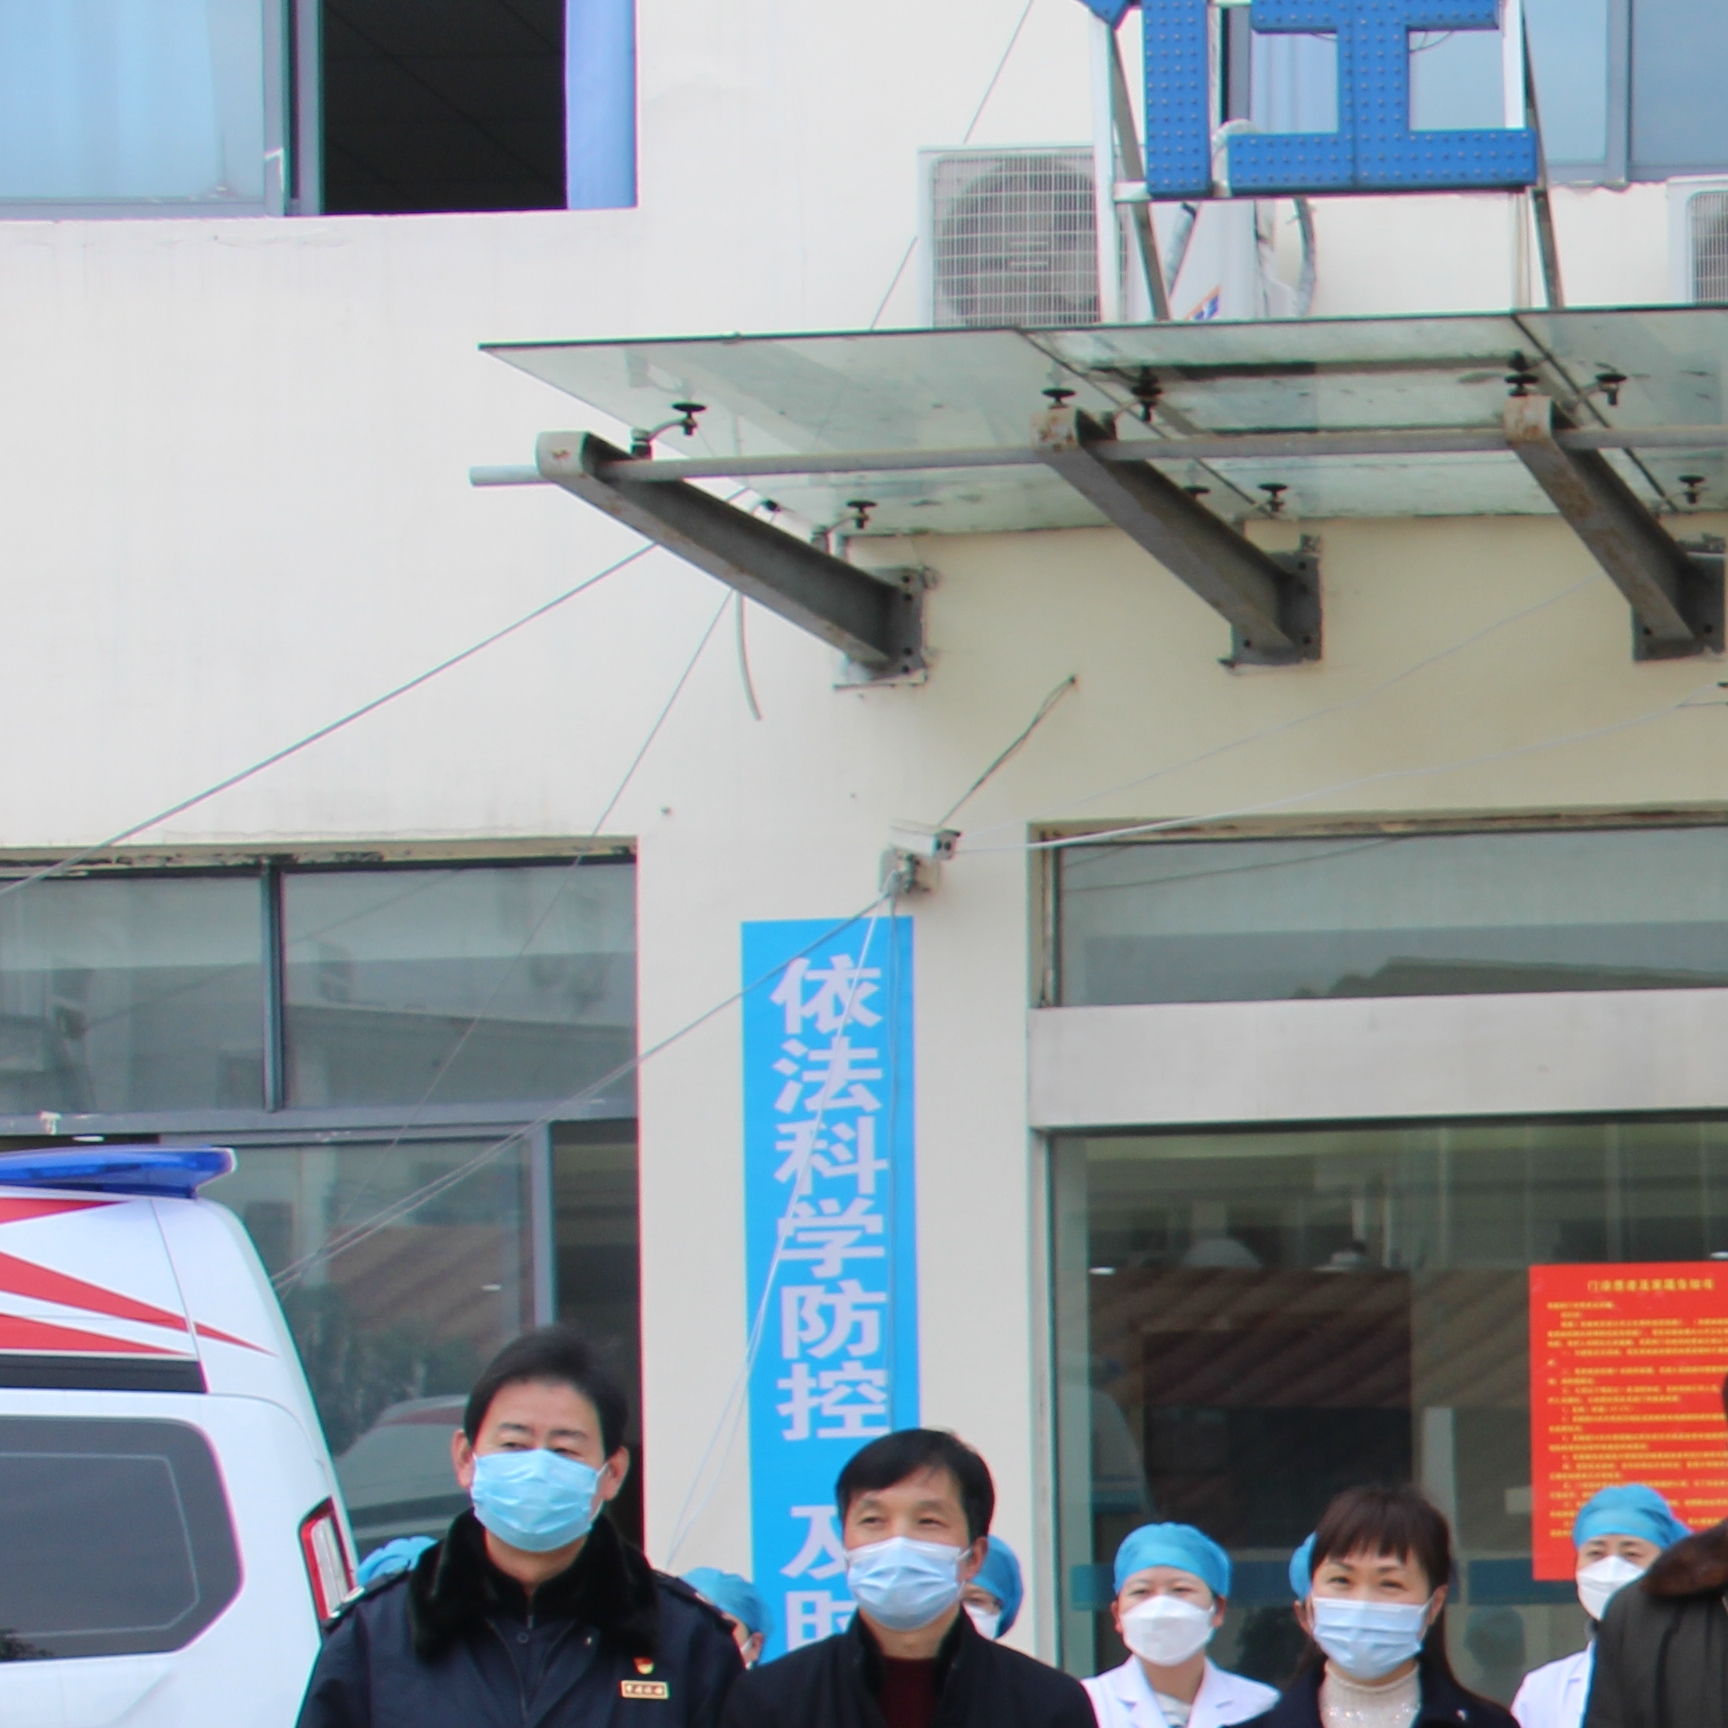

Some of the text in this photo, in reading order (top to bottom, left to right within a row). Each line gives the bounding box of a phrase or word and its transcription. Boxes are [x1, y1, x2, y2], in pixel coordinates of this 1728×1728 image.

[769, 953, 890, 1442] 依法科学防控
